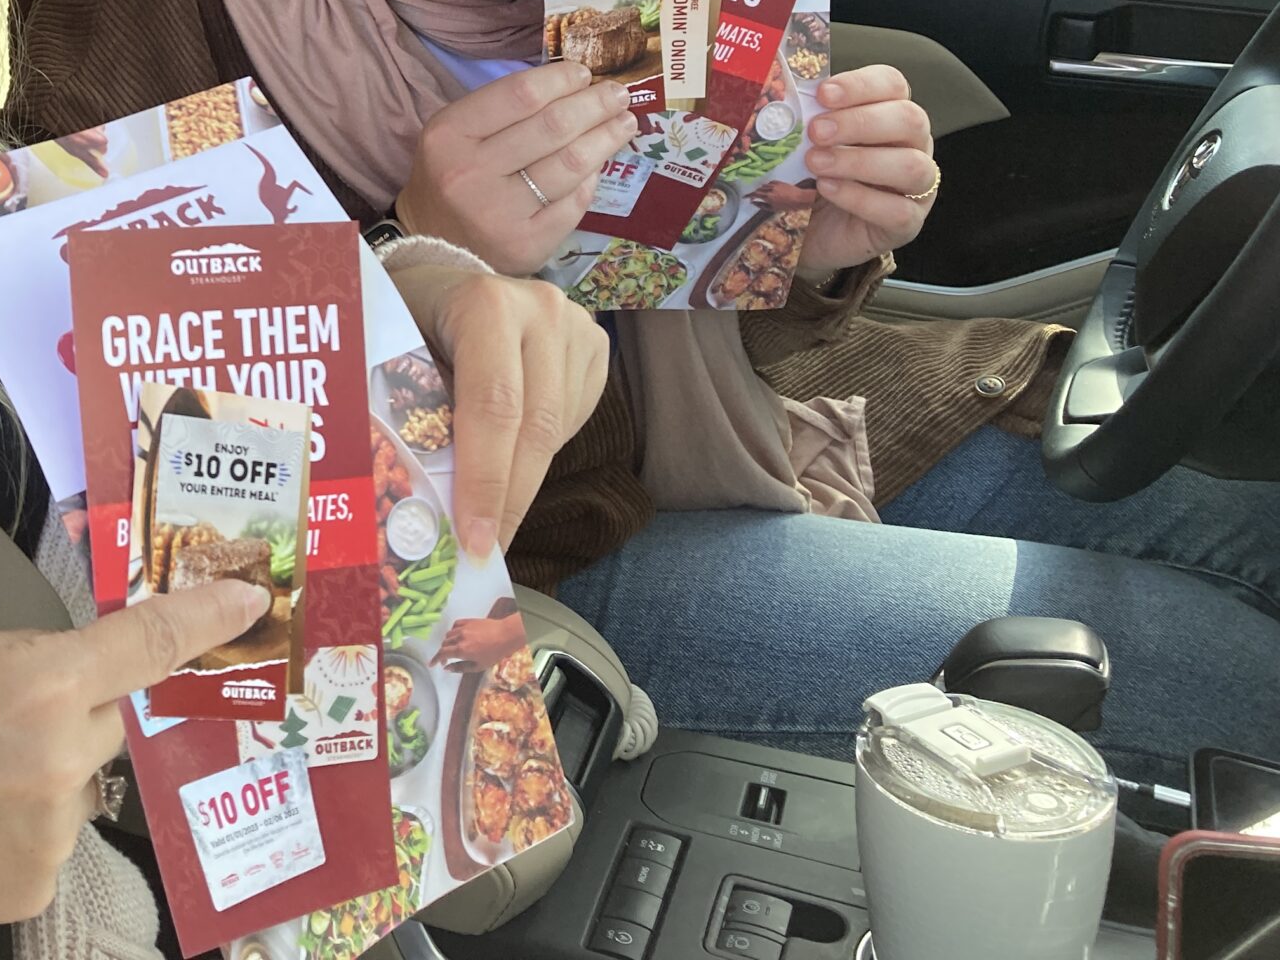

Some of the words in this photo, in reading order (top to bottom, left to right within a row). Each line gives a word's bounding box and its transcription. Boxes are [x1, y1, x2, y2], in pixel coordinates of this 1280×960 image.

[670, 40, 687, 81] ONION
[630, 94, 657, 104] BACK
[664, 164, 705, 182] OUTBACK
[127, 194, 226, 230] BACK
[170, 255, 263, 276] OUTBACK
[101, 310, 225, 367] GRACE
[233, 304, 341, 358] THEM
[226, 358, 329, 407] YOUR
[214, 442, 250, 456] ENJOY
[184, 452, 221, 479] $10
[229, 458, 278, 485] OFF
[179, 481, 208, 496] YOUR
[210, 487, 247, 500] ENTIRE
[308, 493, 353, 522] ATES,
[221, 686, 276, 700] OUTBACK
[315, 738, 374, 756] OUTBACK
[198, 791, 238, 829] $10
[241, 770, 290, 816] OFF
